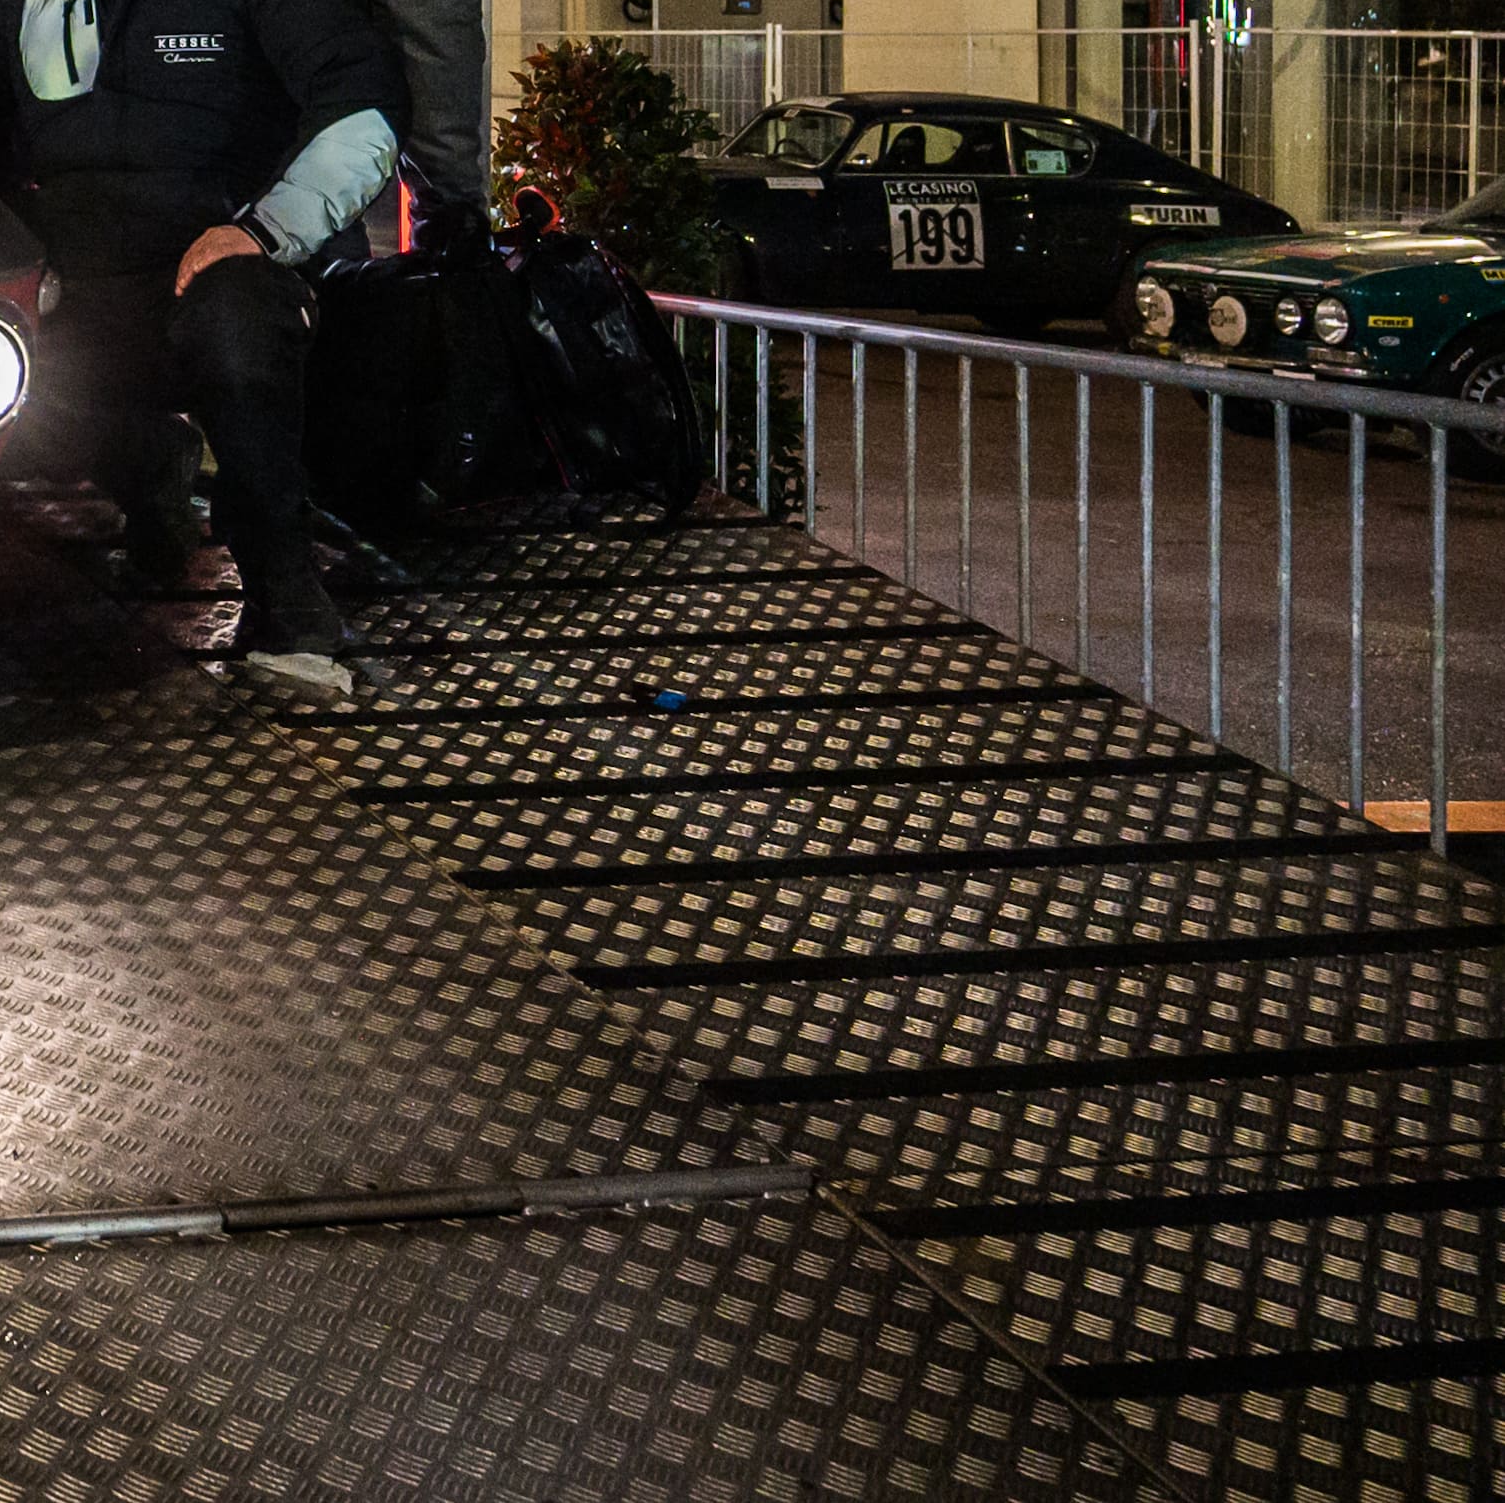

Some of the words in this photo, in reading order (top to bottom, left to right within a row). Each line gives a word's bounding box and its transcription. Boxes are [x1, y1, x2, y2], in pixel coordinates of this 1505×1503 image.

[157, 37, 220, 49] KESSEL
[908, 182, 973, 196] CASINO
[1145, 206, 1207, 224] TURIN
[898, 208, 976, 265] 199
